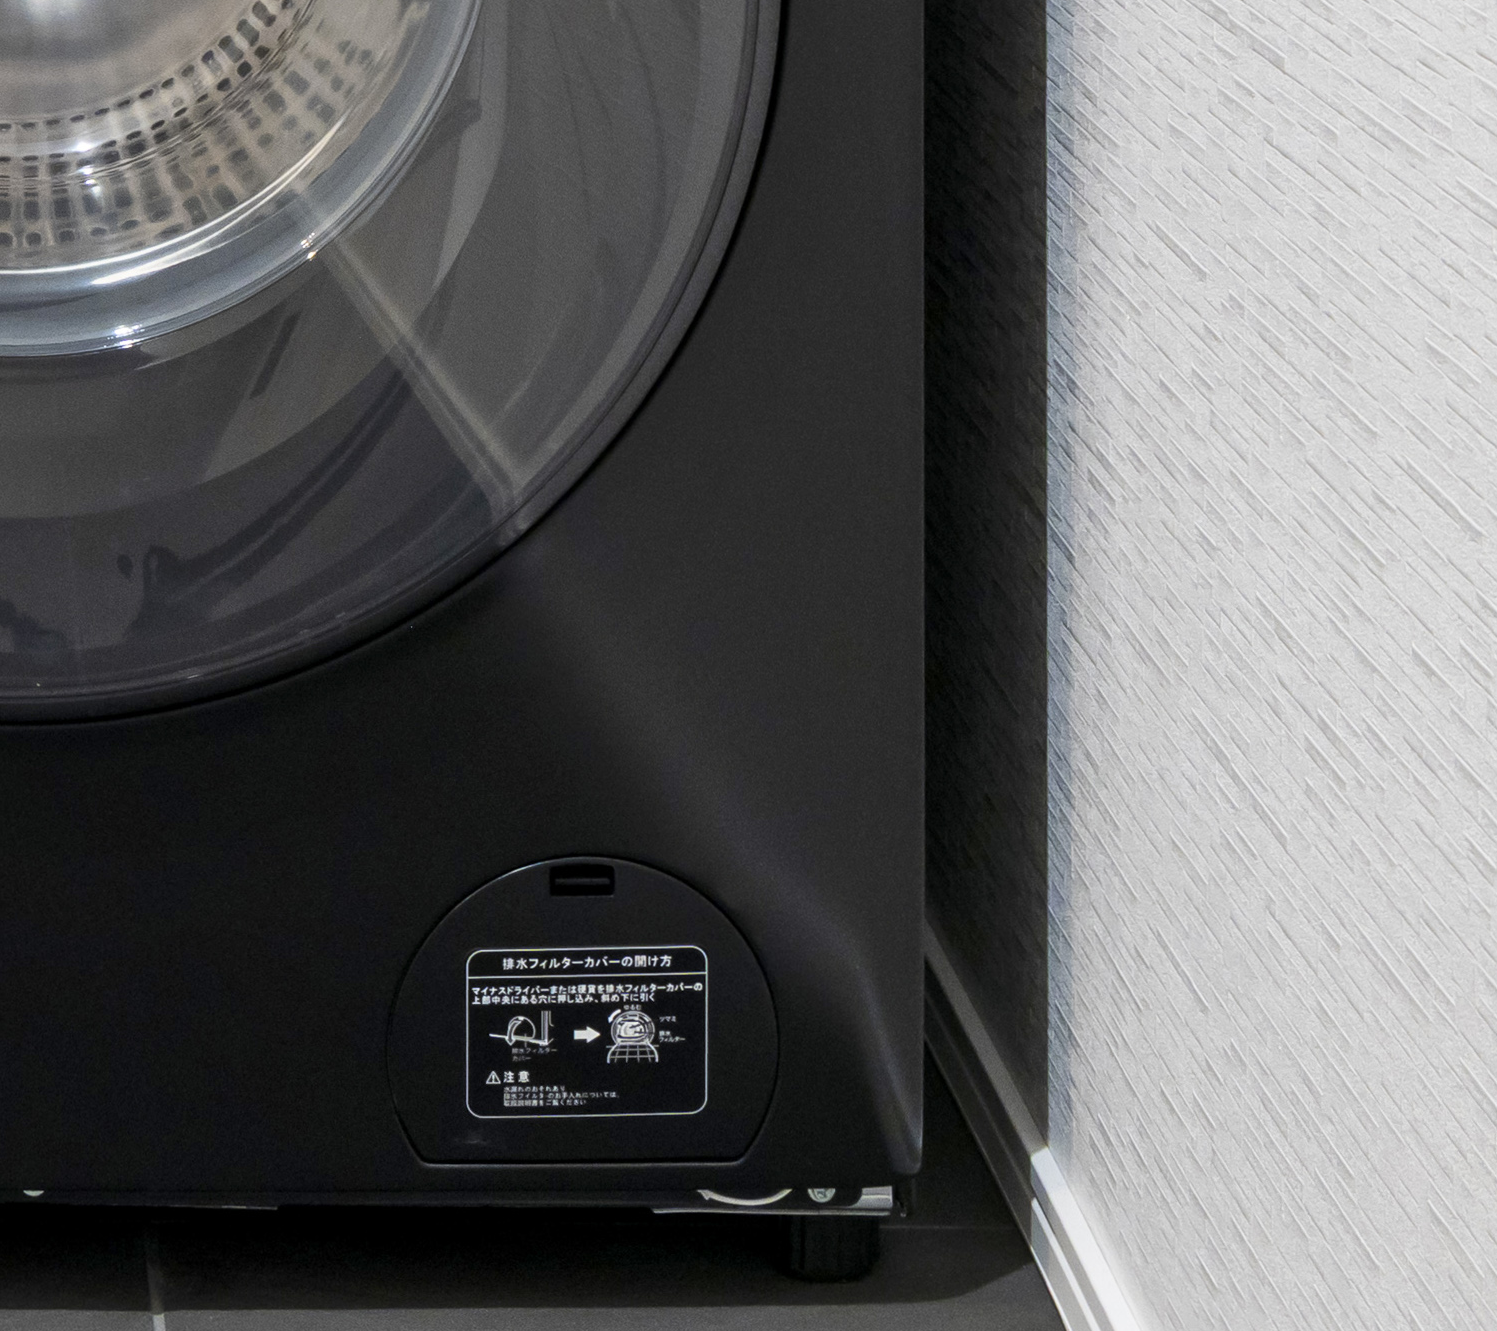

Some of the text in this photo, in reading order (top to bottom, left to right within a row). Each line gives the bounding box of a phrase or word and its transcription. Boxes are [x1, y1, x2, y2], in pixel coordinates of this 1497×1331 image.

[503, 954, 672, 970] 排水フィルターカバーの開け方
[503, 1070, 530, 1083] 注意
